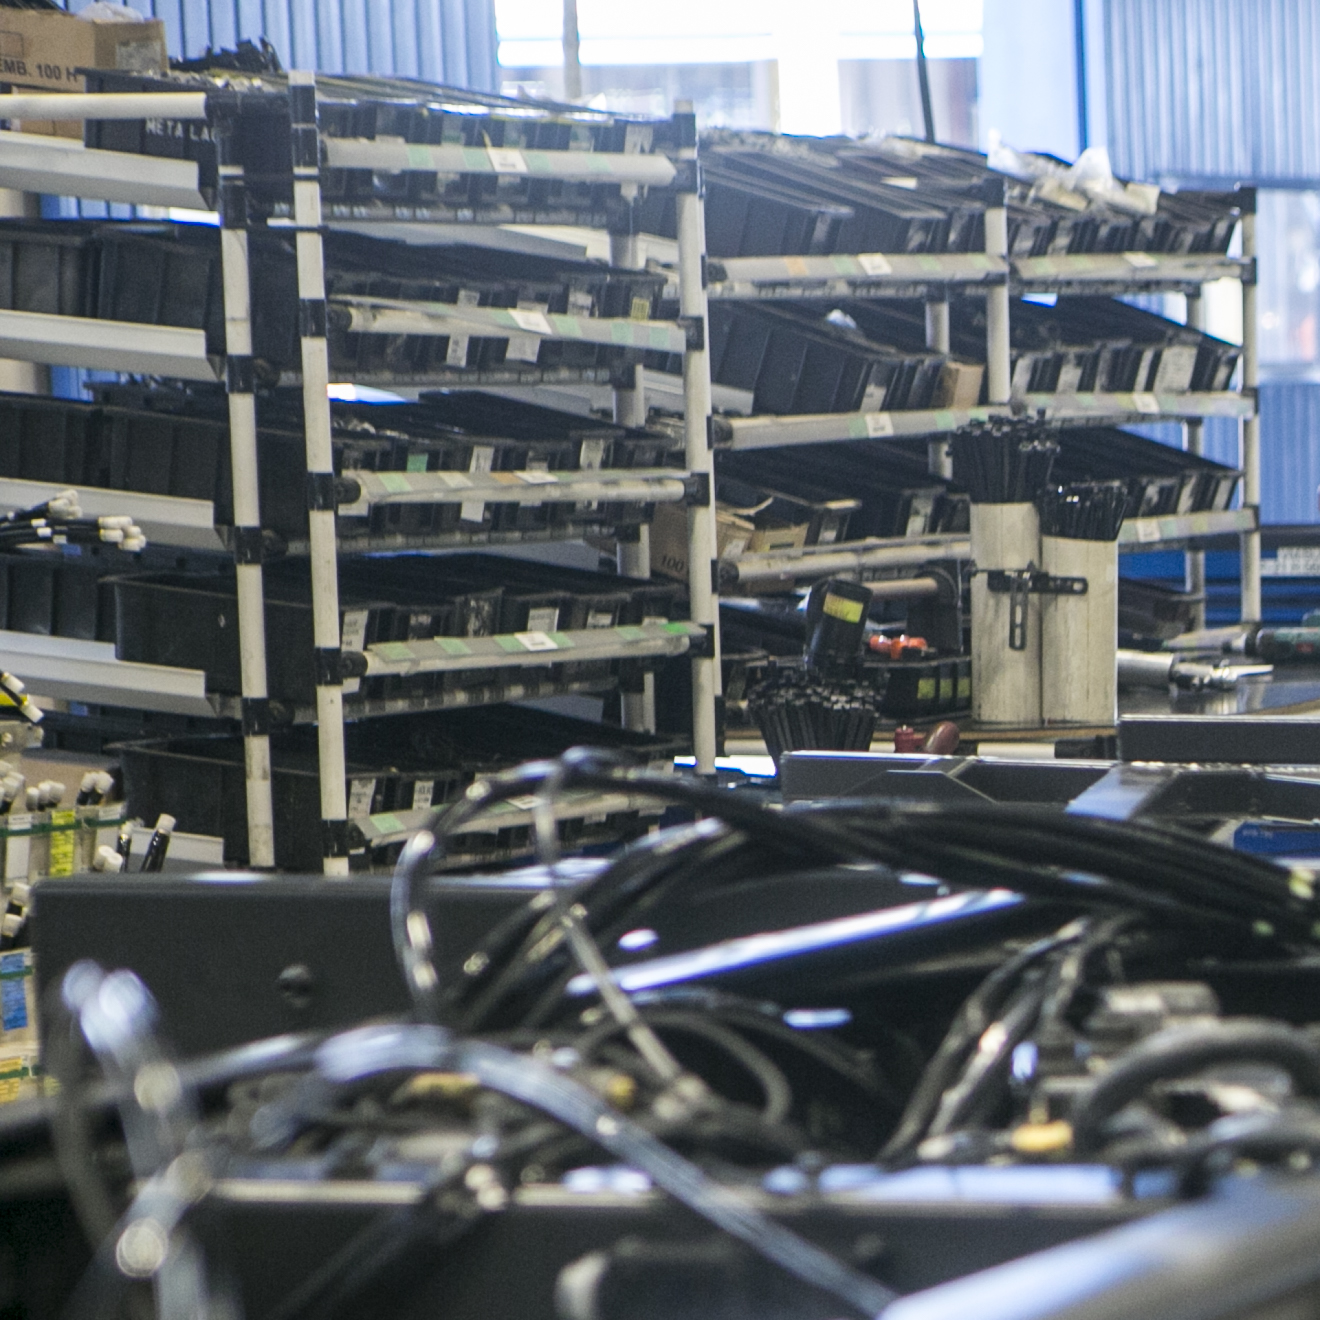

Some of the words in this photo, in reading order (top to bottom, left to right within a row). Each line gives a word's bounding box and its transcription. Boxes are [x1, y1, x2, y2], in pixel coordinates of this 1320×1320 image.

[0, 58, 32, 77] MB.
[36, 63, 62, 80] 100
[661, 555, 684, 572] 100
